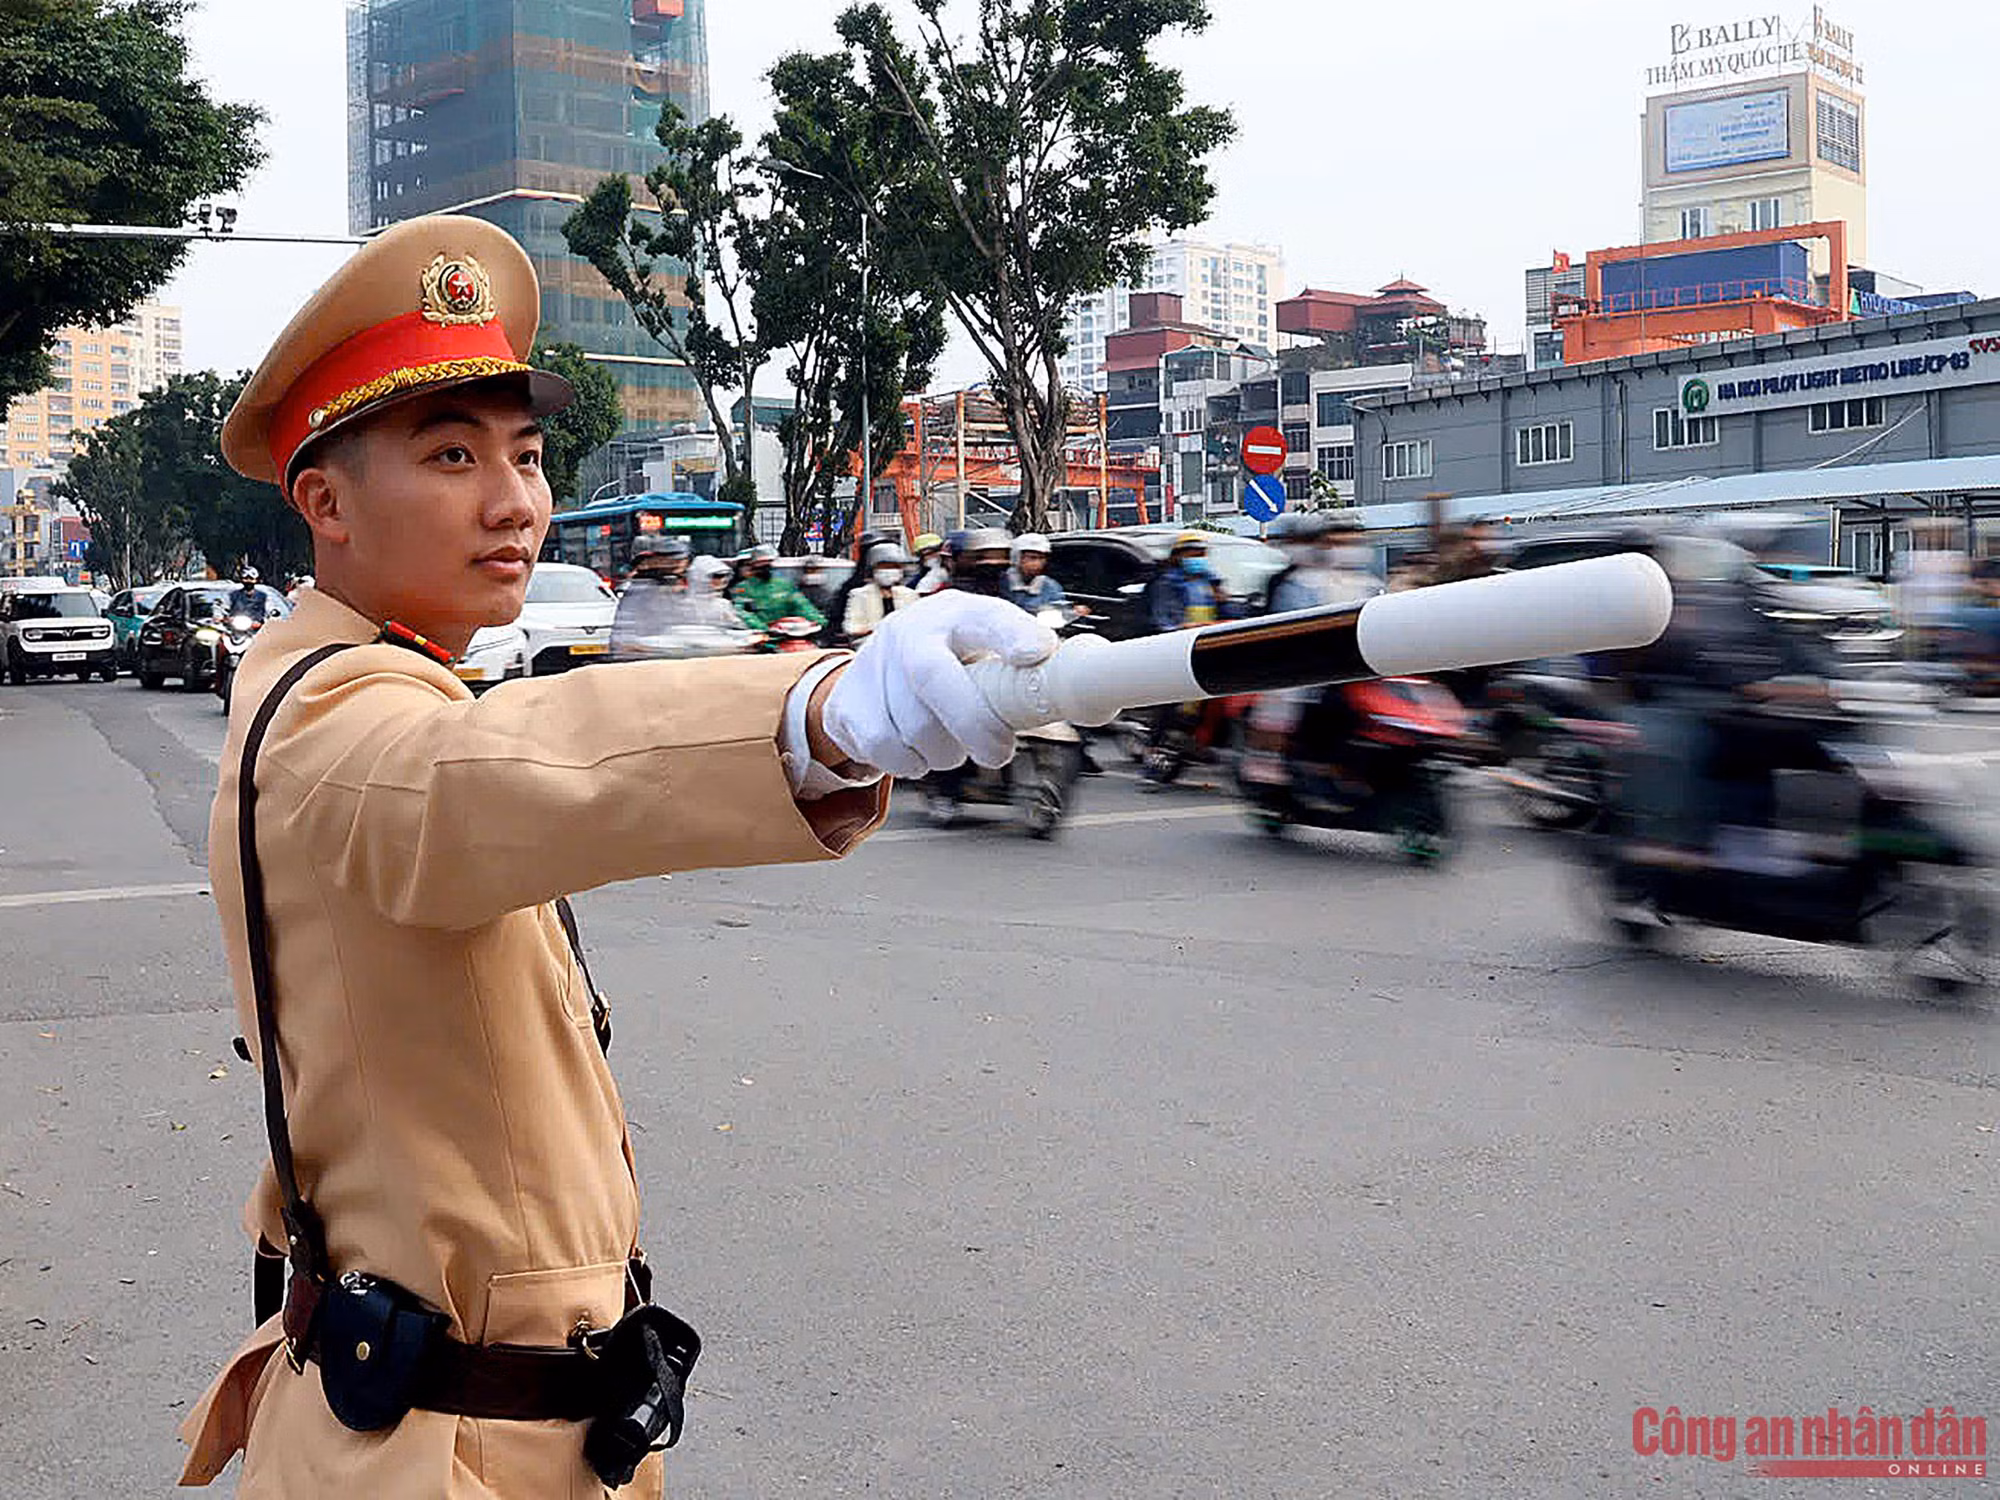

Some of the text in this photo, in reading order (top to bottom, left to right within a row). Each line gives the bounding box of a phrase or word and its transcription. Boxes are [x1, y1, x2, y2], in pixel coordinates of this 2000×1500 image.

[1699, 15, 1776, 48] BALLY
[1799, 369, 1839, 390] LIGHT
[1840, 362, 1889, 385] METRO
